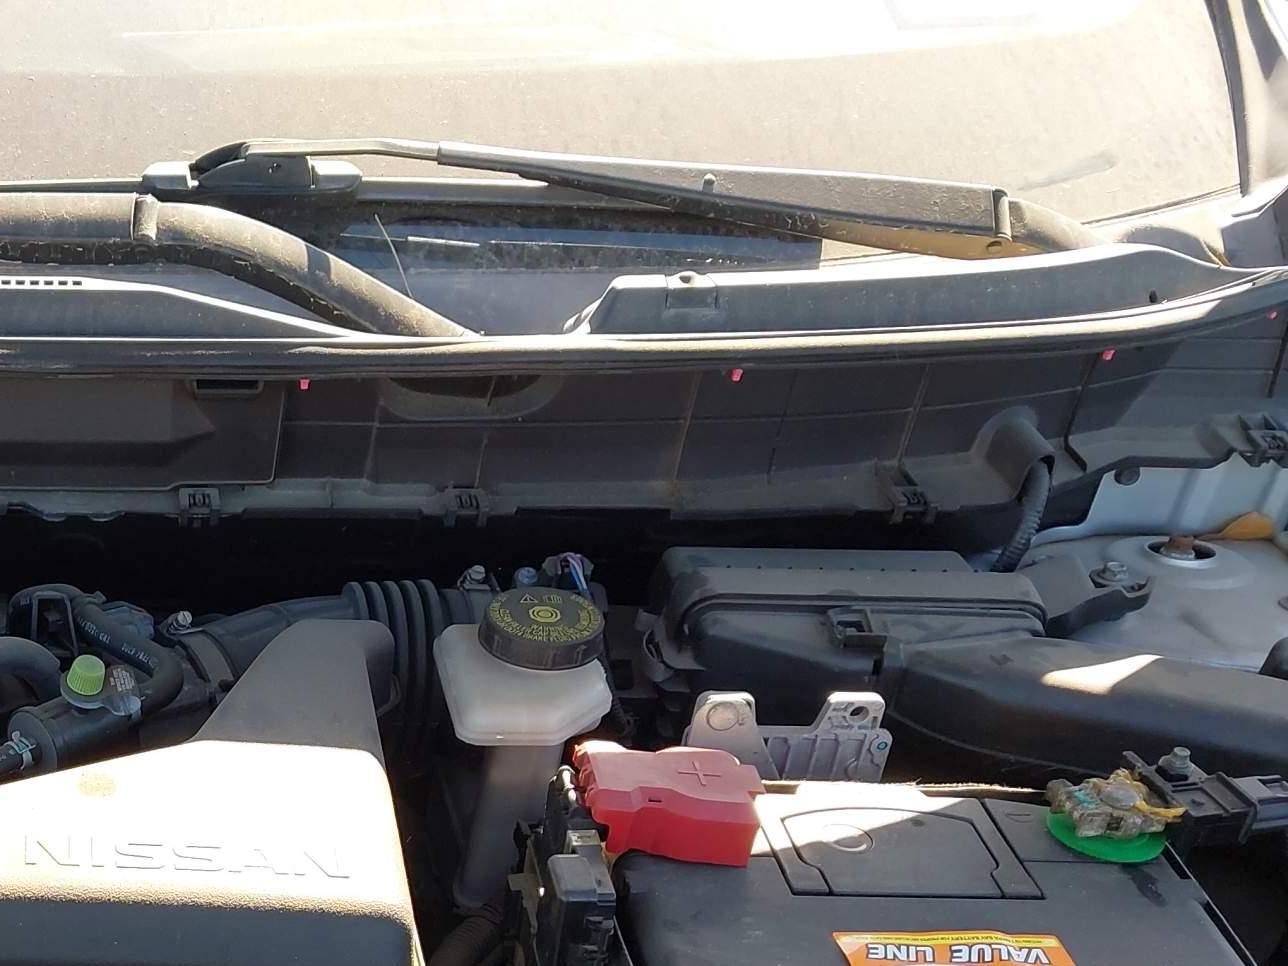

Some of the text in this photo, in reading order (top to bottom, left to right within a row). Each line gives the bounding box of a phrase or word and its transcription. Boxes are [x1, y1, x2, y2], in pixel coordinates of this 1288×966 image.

[25, 833, 350, 879] NISSAN
[867, 943, 1051, 964] VALUE LINE
